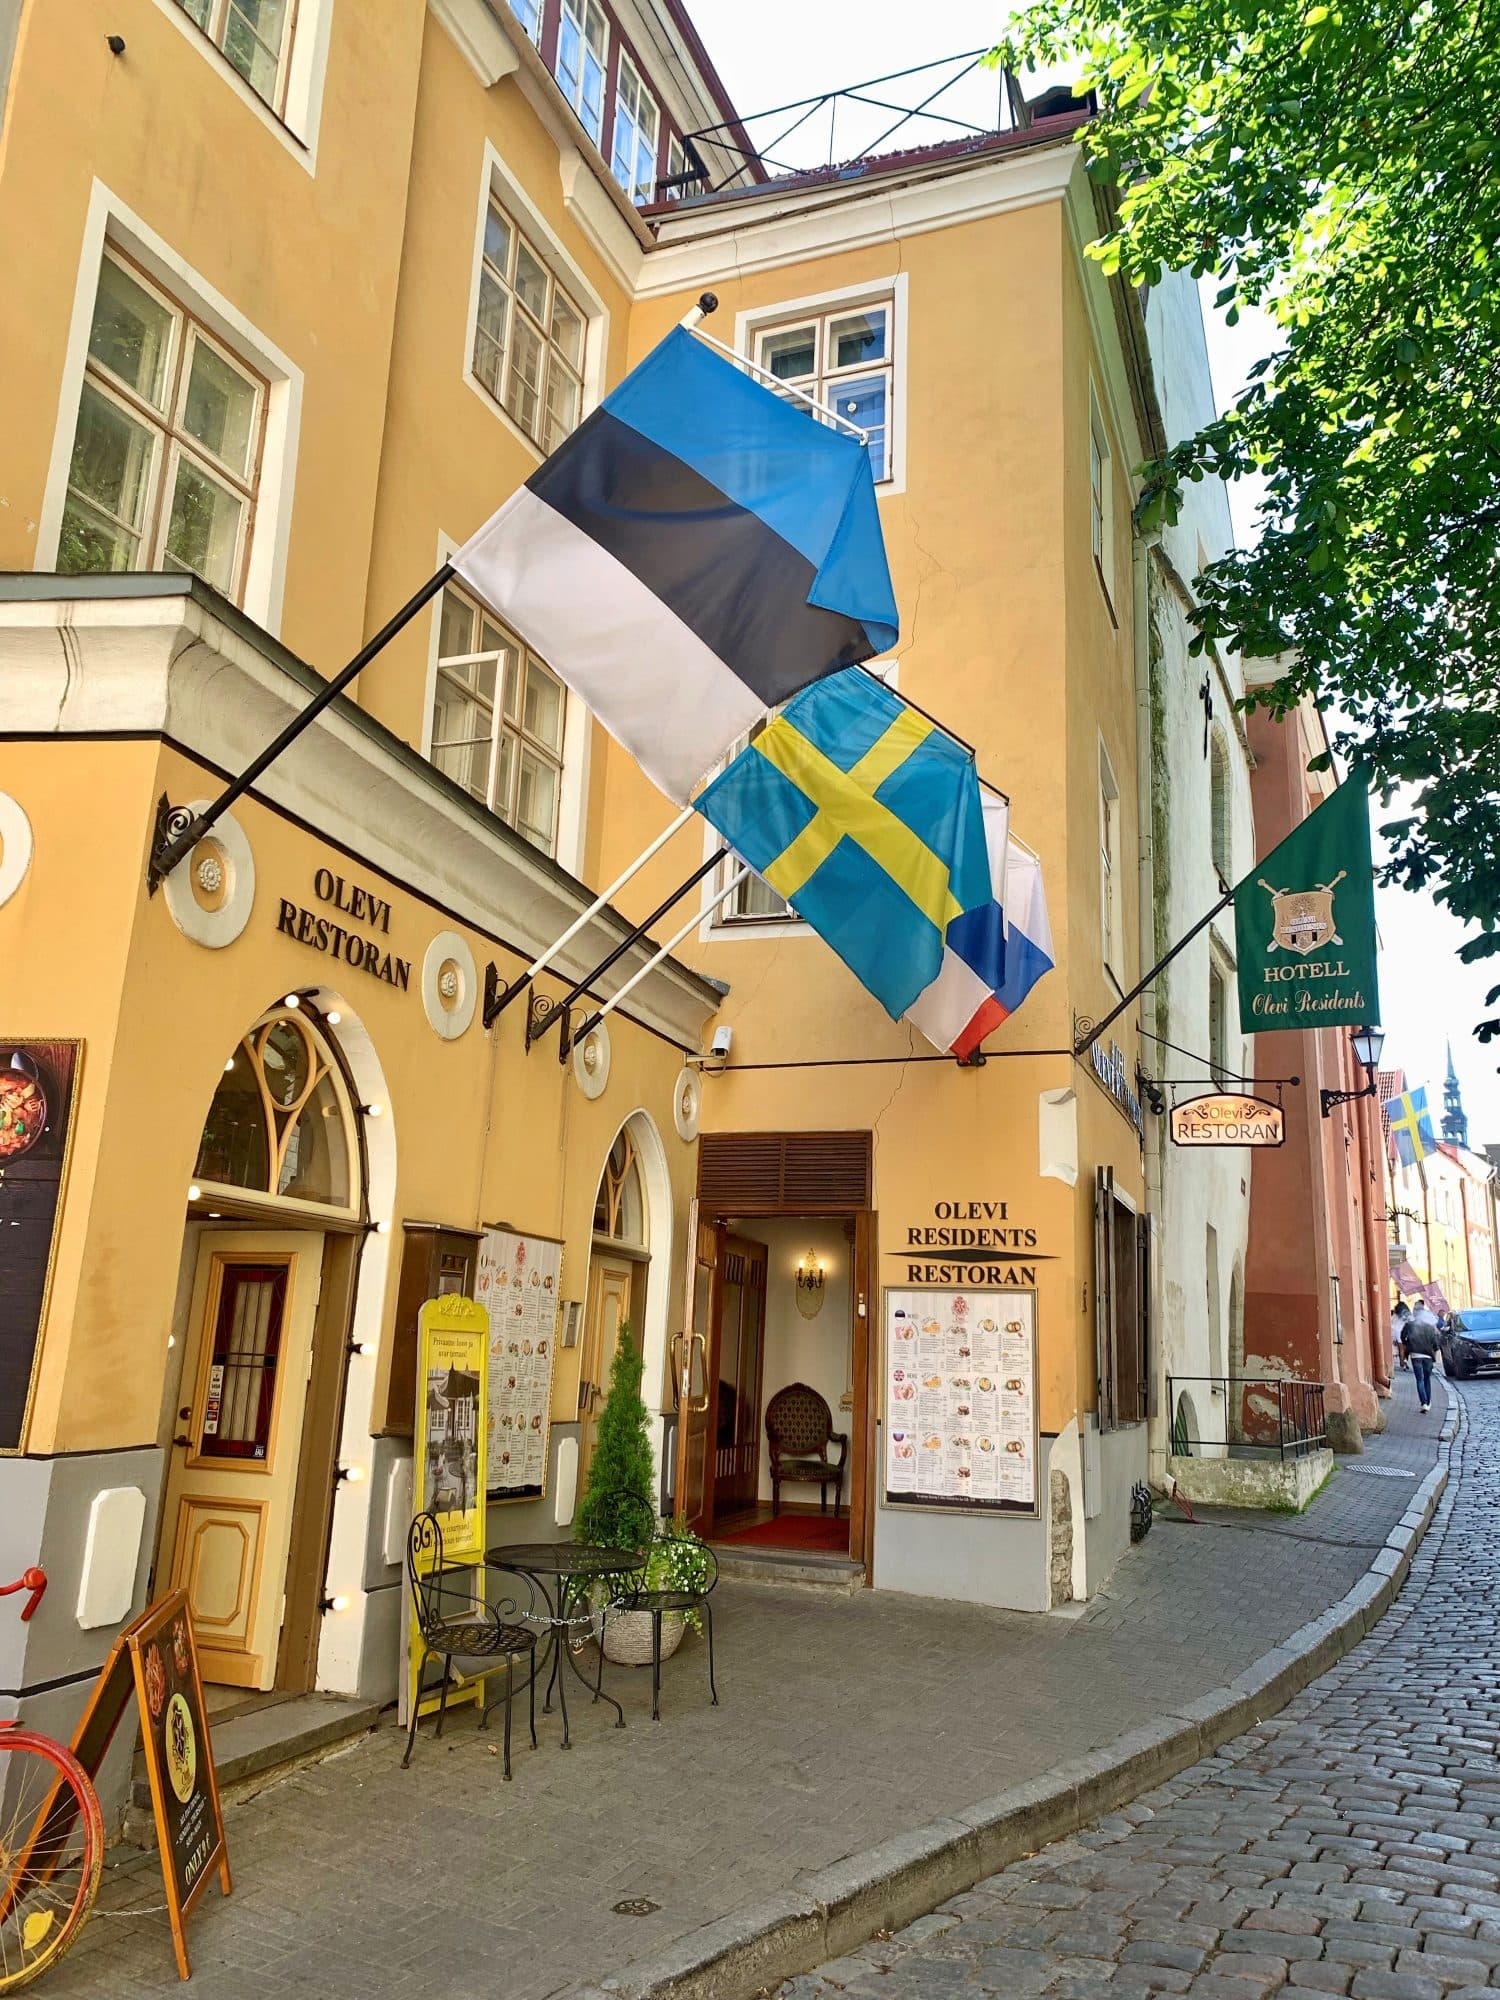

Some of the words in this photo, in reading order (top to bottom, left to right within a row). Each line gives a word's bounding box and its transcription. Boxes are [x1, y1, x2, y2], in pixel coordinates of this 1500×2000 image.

[314, 868, 392, 934] OLEVI
[276, 897, 412, 992] RESTORAN
[1263, 961, 1350, 982] HOTELL
[1252, 993, 1288, 1016] Olevi
[1294, 989, 1366, 1013] Residents
[1209, 1106, 1243, 1119] Olevi
[1178, 1123, 1278, 1139] RESTORAN
[934, 1201, 1008, 1220] OLEVI
[907, 1227, 1037, 1247] RESIDENTS
[907, 1264, 1037, 1285] RESTORAN
[184, 1844, 204, 1886] ONLY
